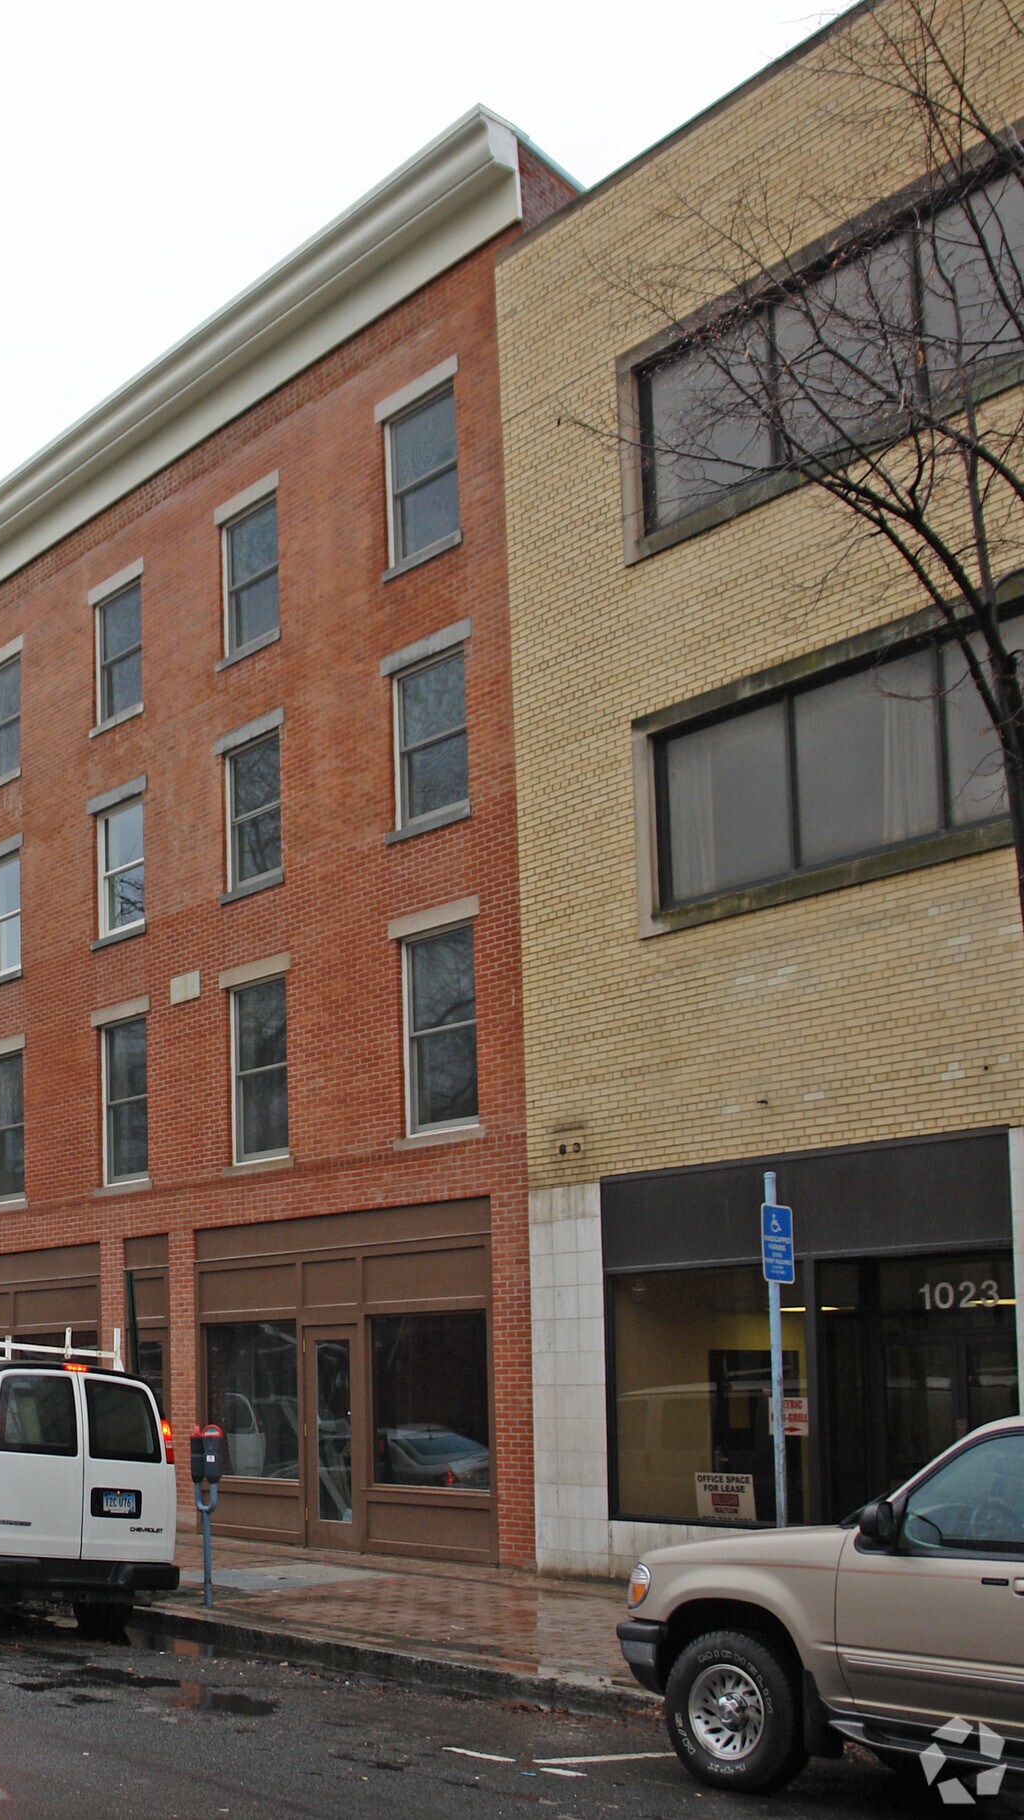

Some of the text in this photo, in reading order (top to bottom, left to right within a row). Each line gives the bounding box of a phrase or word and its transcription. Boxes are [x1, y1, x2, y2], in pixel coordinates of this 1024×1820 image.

[919, 1280, 1000, 1310] 1023
[783, 1400, 804, 1410] ETRIC
[697, 1475, 751, 1485] OFFICE SPACE
[703, 1484, 746, 1494] FOR LEASE
[129, 1526, 164, 1534] CHEVROLET
[697, 1649, 774, 1714] MICHELIN
